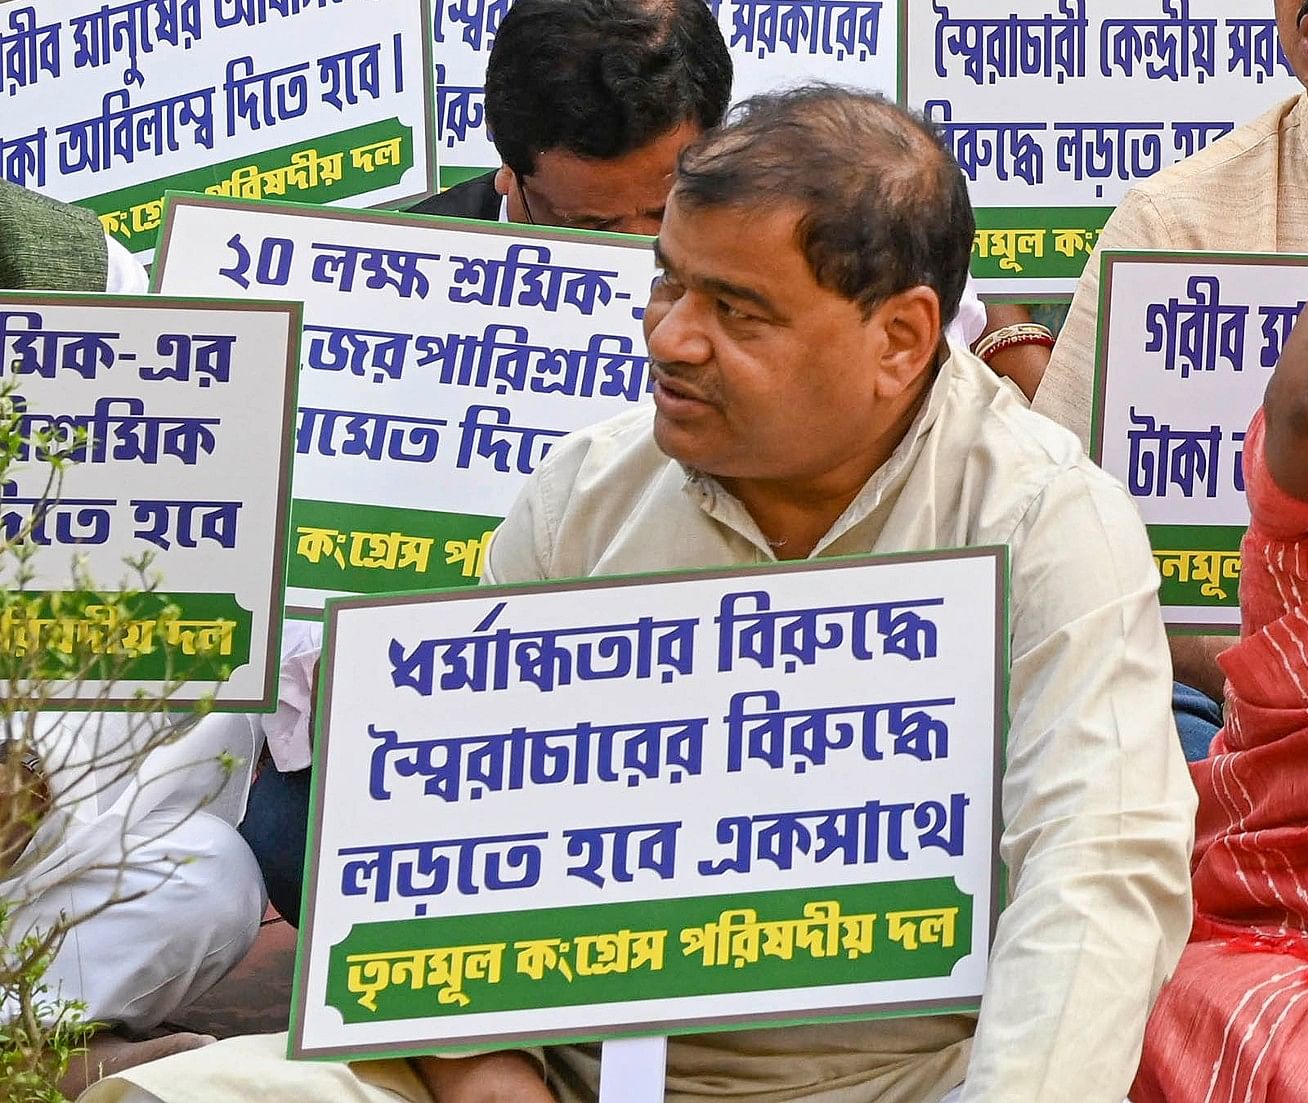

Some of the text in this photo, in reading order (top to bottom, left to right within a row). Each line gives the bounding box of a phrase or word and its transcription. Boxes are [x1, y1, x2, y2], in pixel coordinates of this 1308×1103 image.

[55, 86, 217, 176] অবিলম্বে
[222, 55, 308, 138] দিতে
[317, 43, 379, 111] হবে
[350, 137, 398, 172] দল
[1053, 121, 1163, 198] লড়তে
[218, 233, 439, 299] ২০ লক্ষ
[0, 311, 235, 389] মিক-এর
[1144, 275, 1248, 378] গরীব
[1127, 408, 1221, 498] টাকা
[131, 499, 240, 551] হবে
[296, 526, 432, 572] কংগ্রেস
[387, 590, 942, 698] ধর্মান্ধতার বিরুদ্ধে
[366, 689, 954, 804] স্বৈরাচারের বিরুদ্ধে
[337, 793, 968, 918] লড়তে হবে একসাথে
[512, 928, 666, 981] কংগ্রেস
[678, 900, 875, 968] পরিষদীয়
[885, 906, 956, 950] দল
